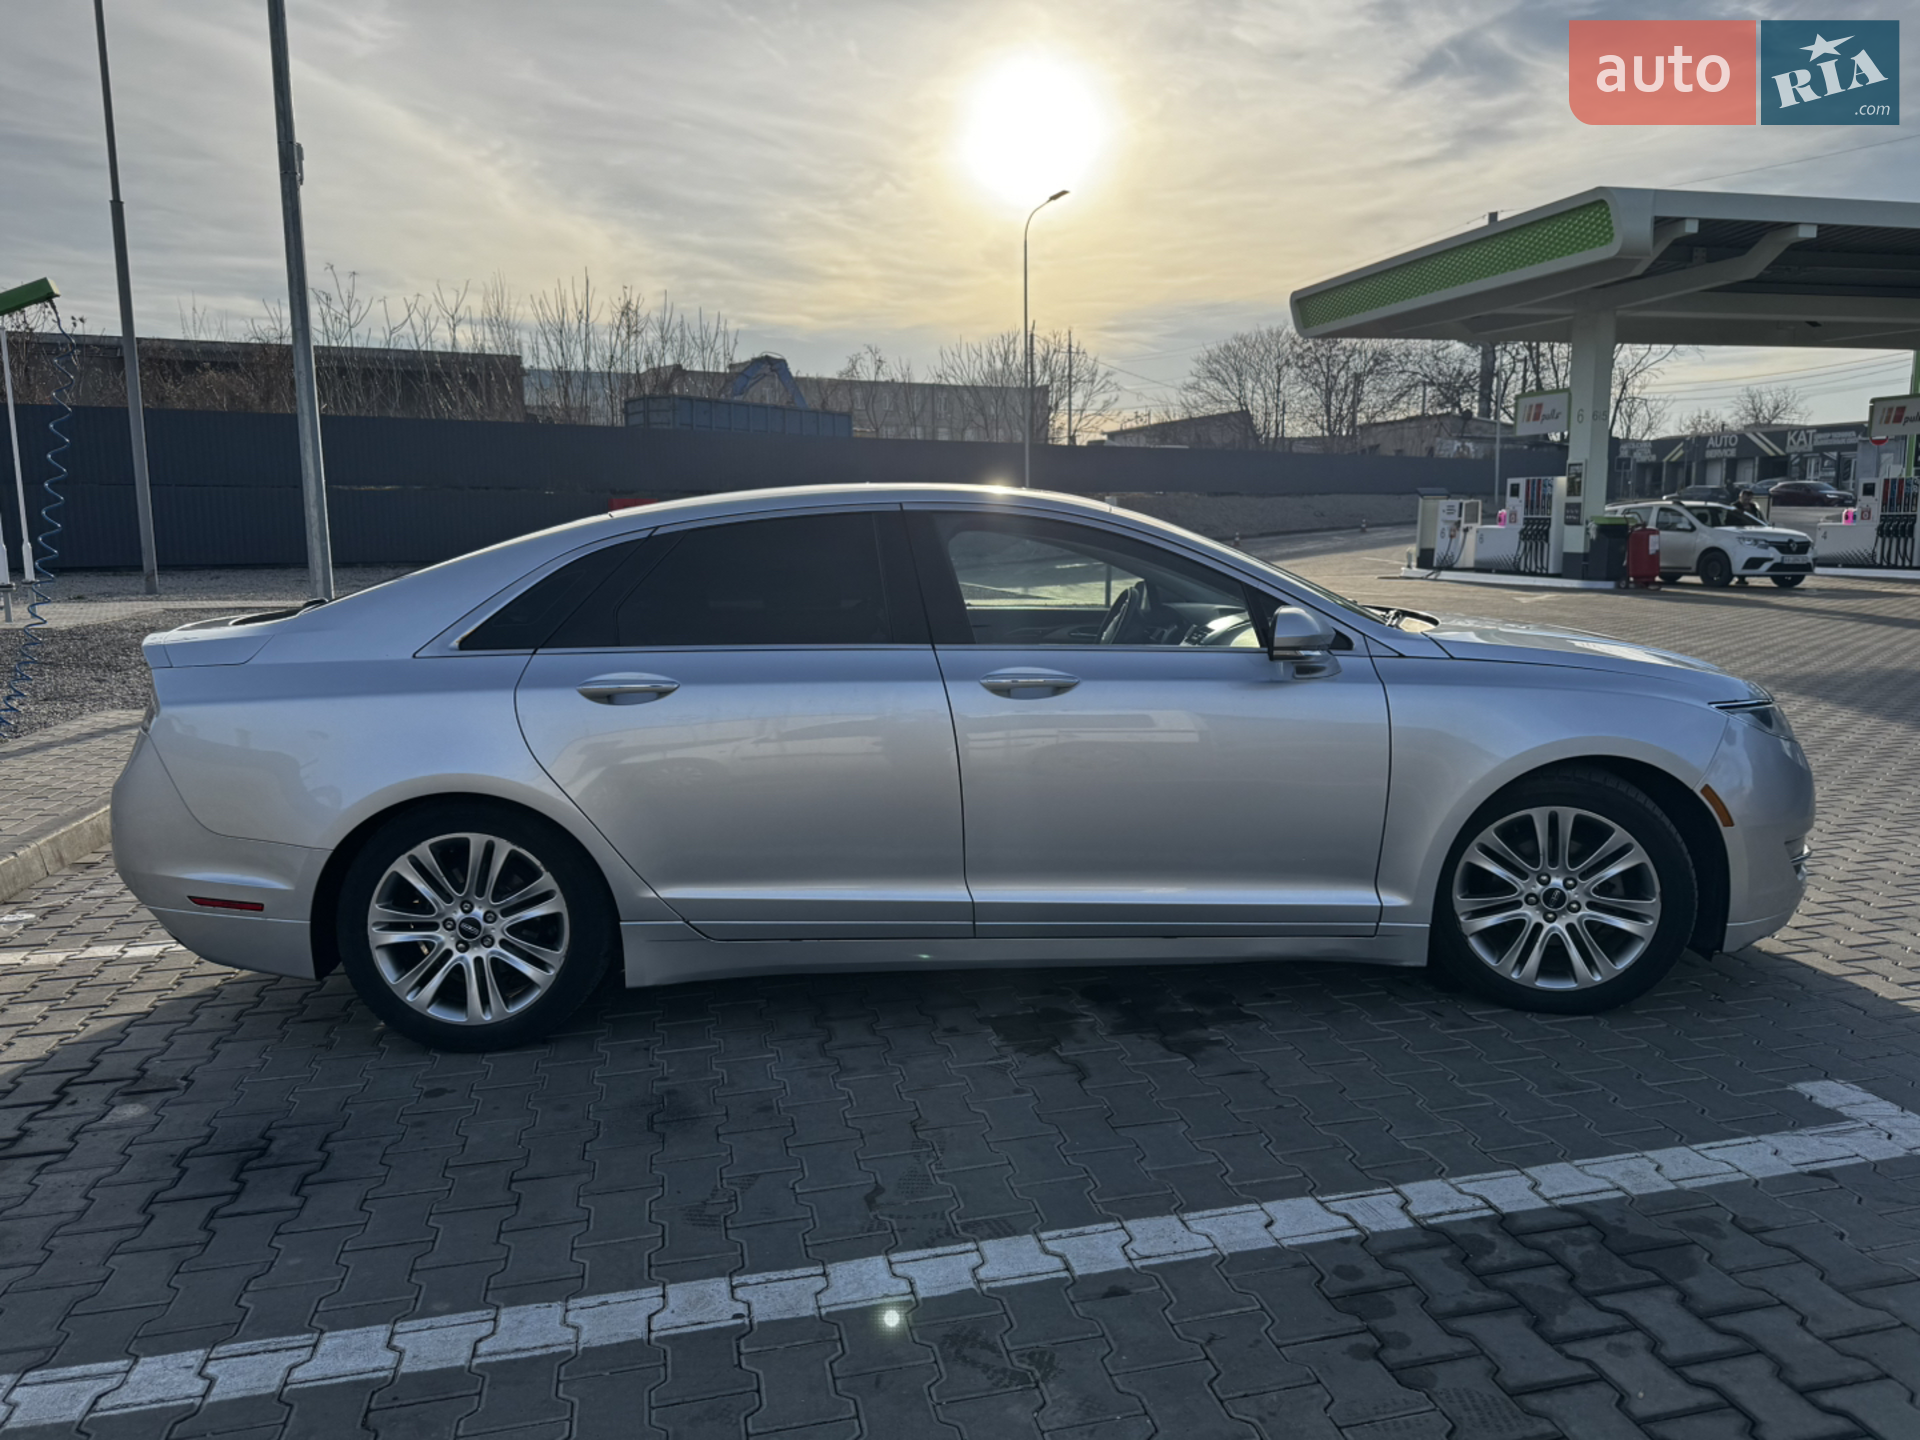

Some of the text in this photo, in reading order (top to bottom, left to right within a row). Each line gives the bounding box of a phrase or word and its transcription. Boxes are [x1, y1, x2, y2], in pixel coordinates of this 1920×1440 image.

[1577, 408, 1584, 424] 6
[1706, 434, 1738, 448] AUTO
[1821, 530, 1828, 540] 4
